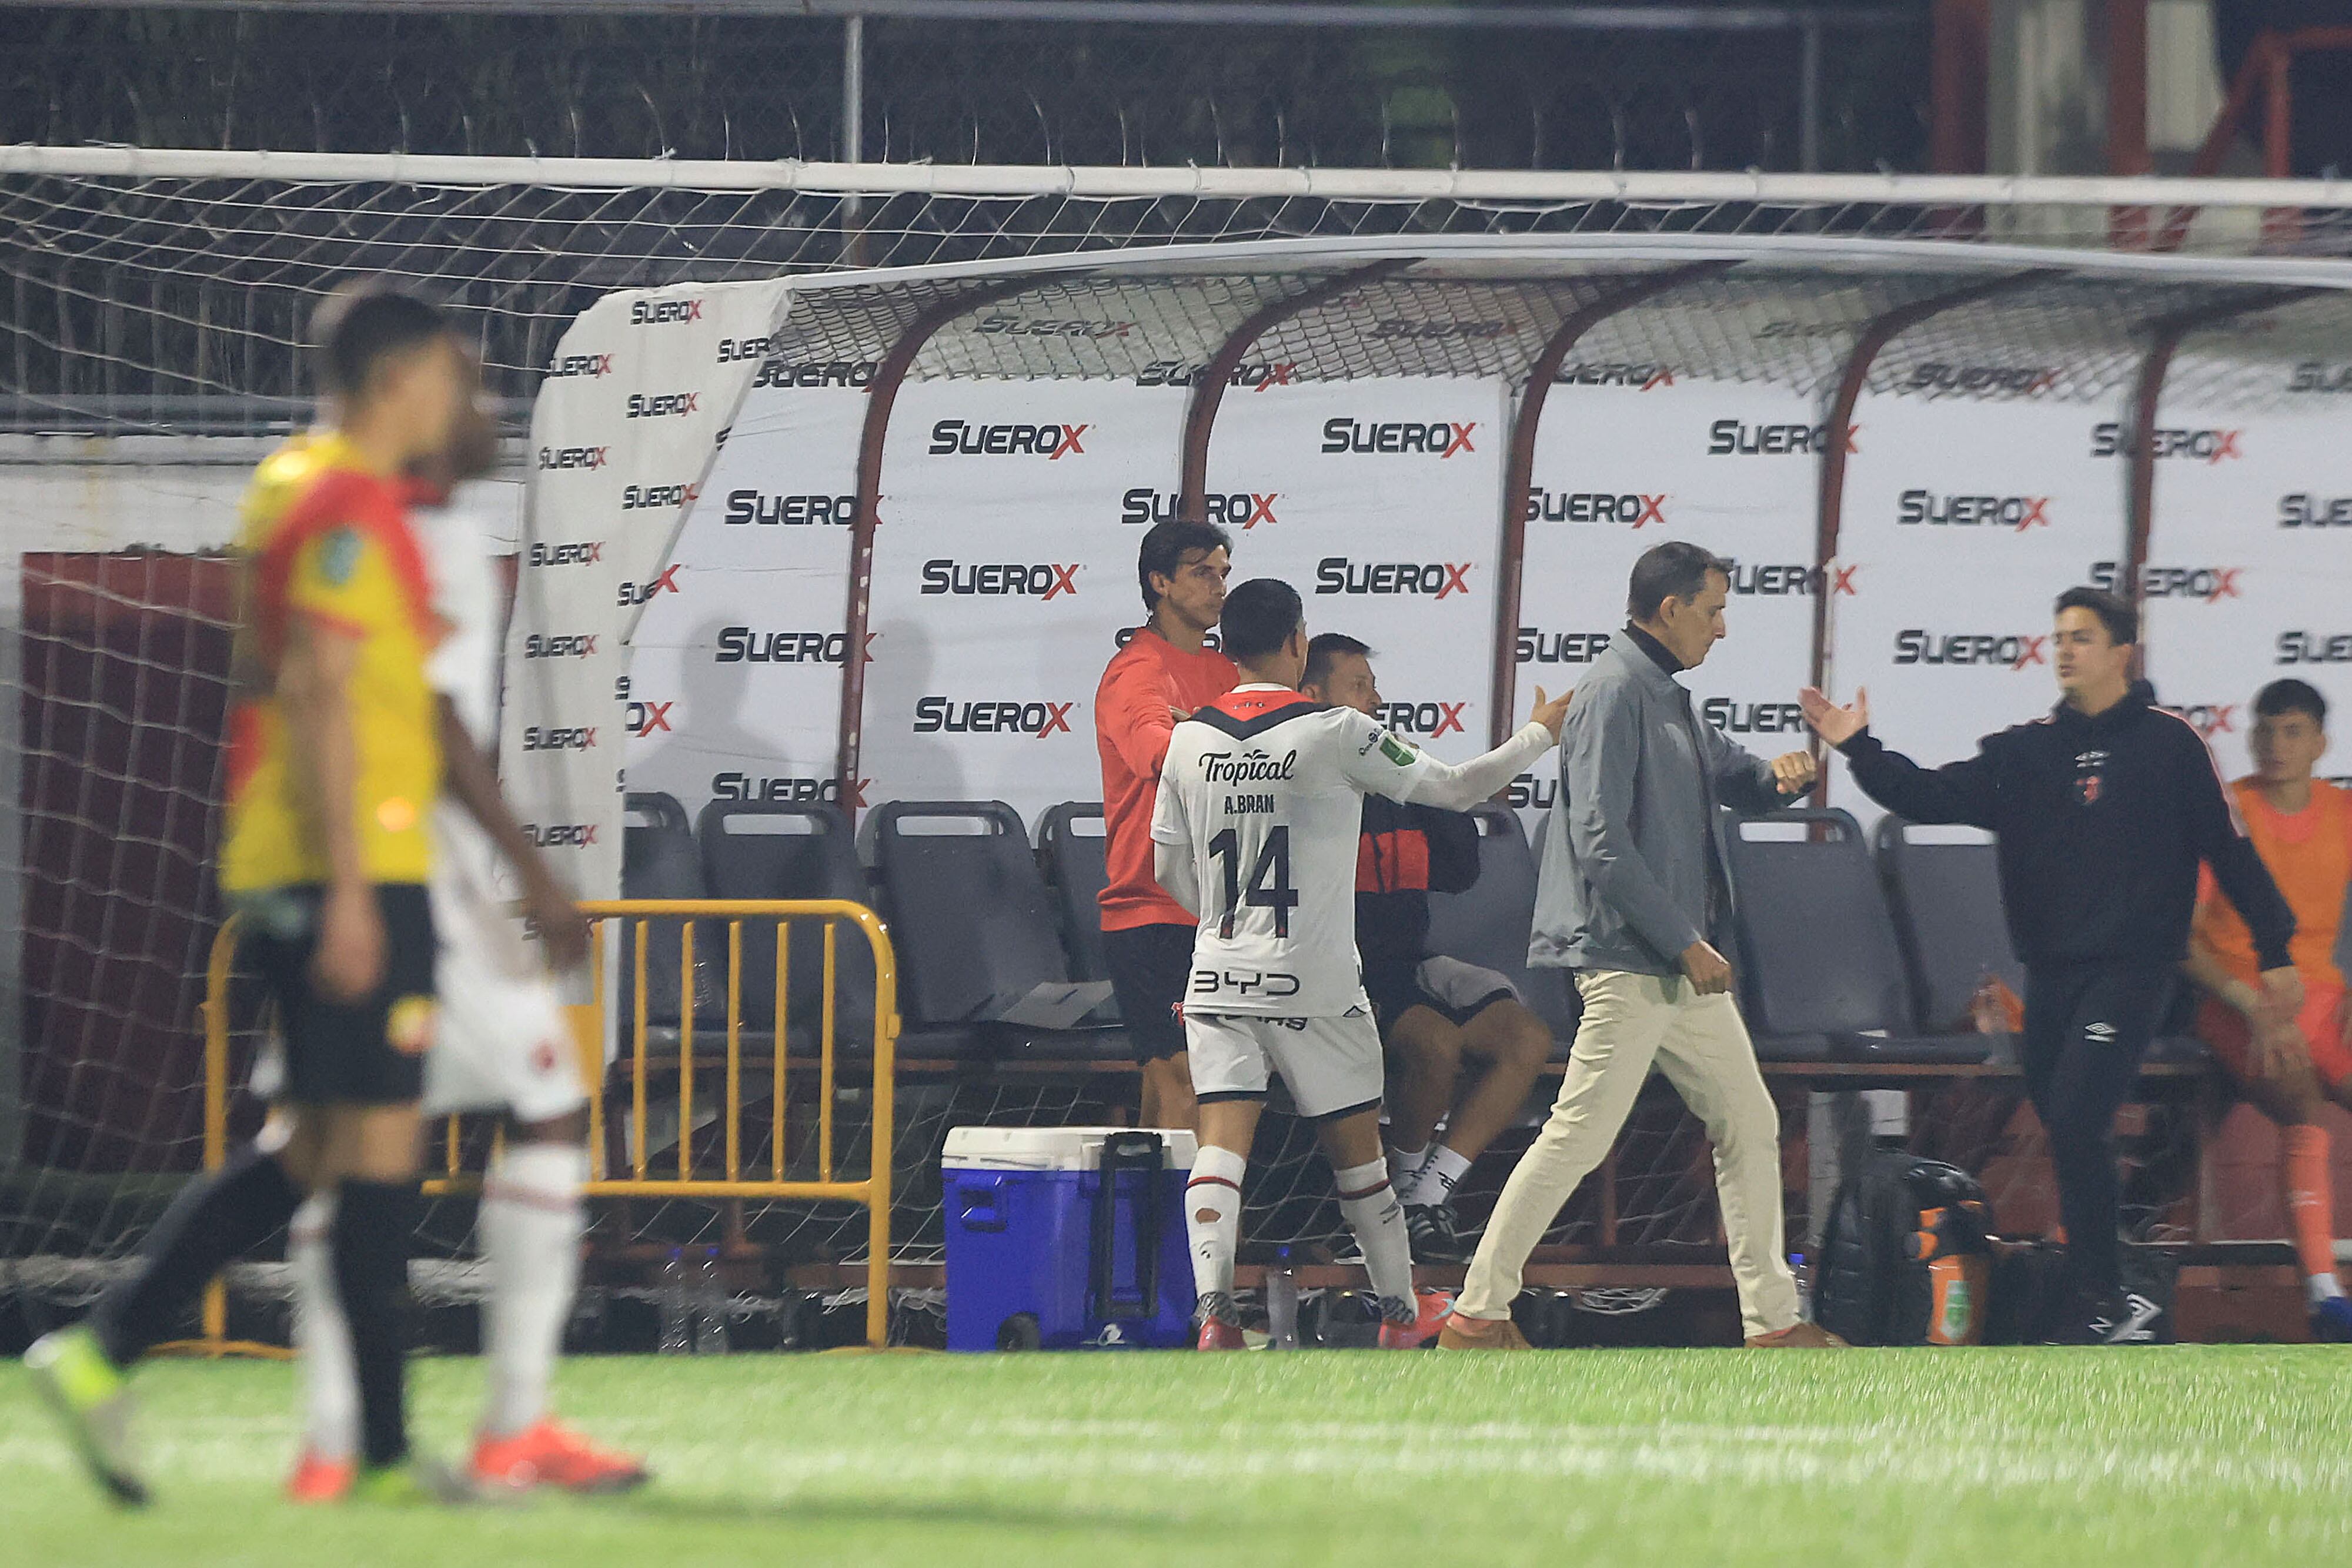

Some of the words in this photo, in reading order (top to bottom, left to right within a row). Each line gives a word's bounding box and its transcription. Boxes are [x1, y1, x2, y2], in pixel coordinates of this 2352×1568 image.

[630, 299, 705, 325] SUEROX
[549, 354, 613, 379] UEROX
[717, 337, 770, 363] SUER
[752, 360, 880, 392] SUERO
[626, 392, 701, 418] SUEROX
[928, 419, 1089, 460] SUEROX
[1321, 418, 1476, 459] SUEROX
[2090, 423, 2243, 464] SEROX
[539, 446, 610, 470] SUEROX
[622, 482, 699, 510] SUEROX
[724, 490, 884, 531] SUERO
[1121, 488, 1278, 529] SUROX
[1526, 487, 1666, 529] SUEROX
[1897, 489, 2052, 533] SUEROX
[2280, 493, 2352, 528] SUE
[529, 541, 606, 567] SUEROX
[921, 559, 1080, 601] SUEROX
[1315, 557, 1471, 600] SUEROX
[524, 634, 599, 659] SUEROX
[1515, 627, 1611, 663] SUER
[1892, 629, 2046, 671] SUEROX
[2276, 631, 2352, 664] SUE
[913, 696, 1074, 739] SUEROX
[1705, 697, 1805, 733] SUER
[523, 727, 599, 752] SUEROX
[1198, 750, 1297, 786] Tropical
[1224, 794, 1275, 815] A.BRAN
[1208, 825, 1298, 940] 14
[1194, 970, 1300, 996] BYD
